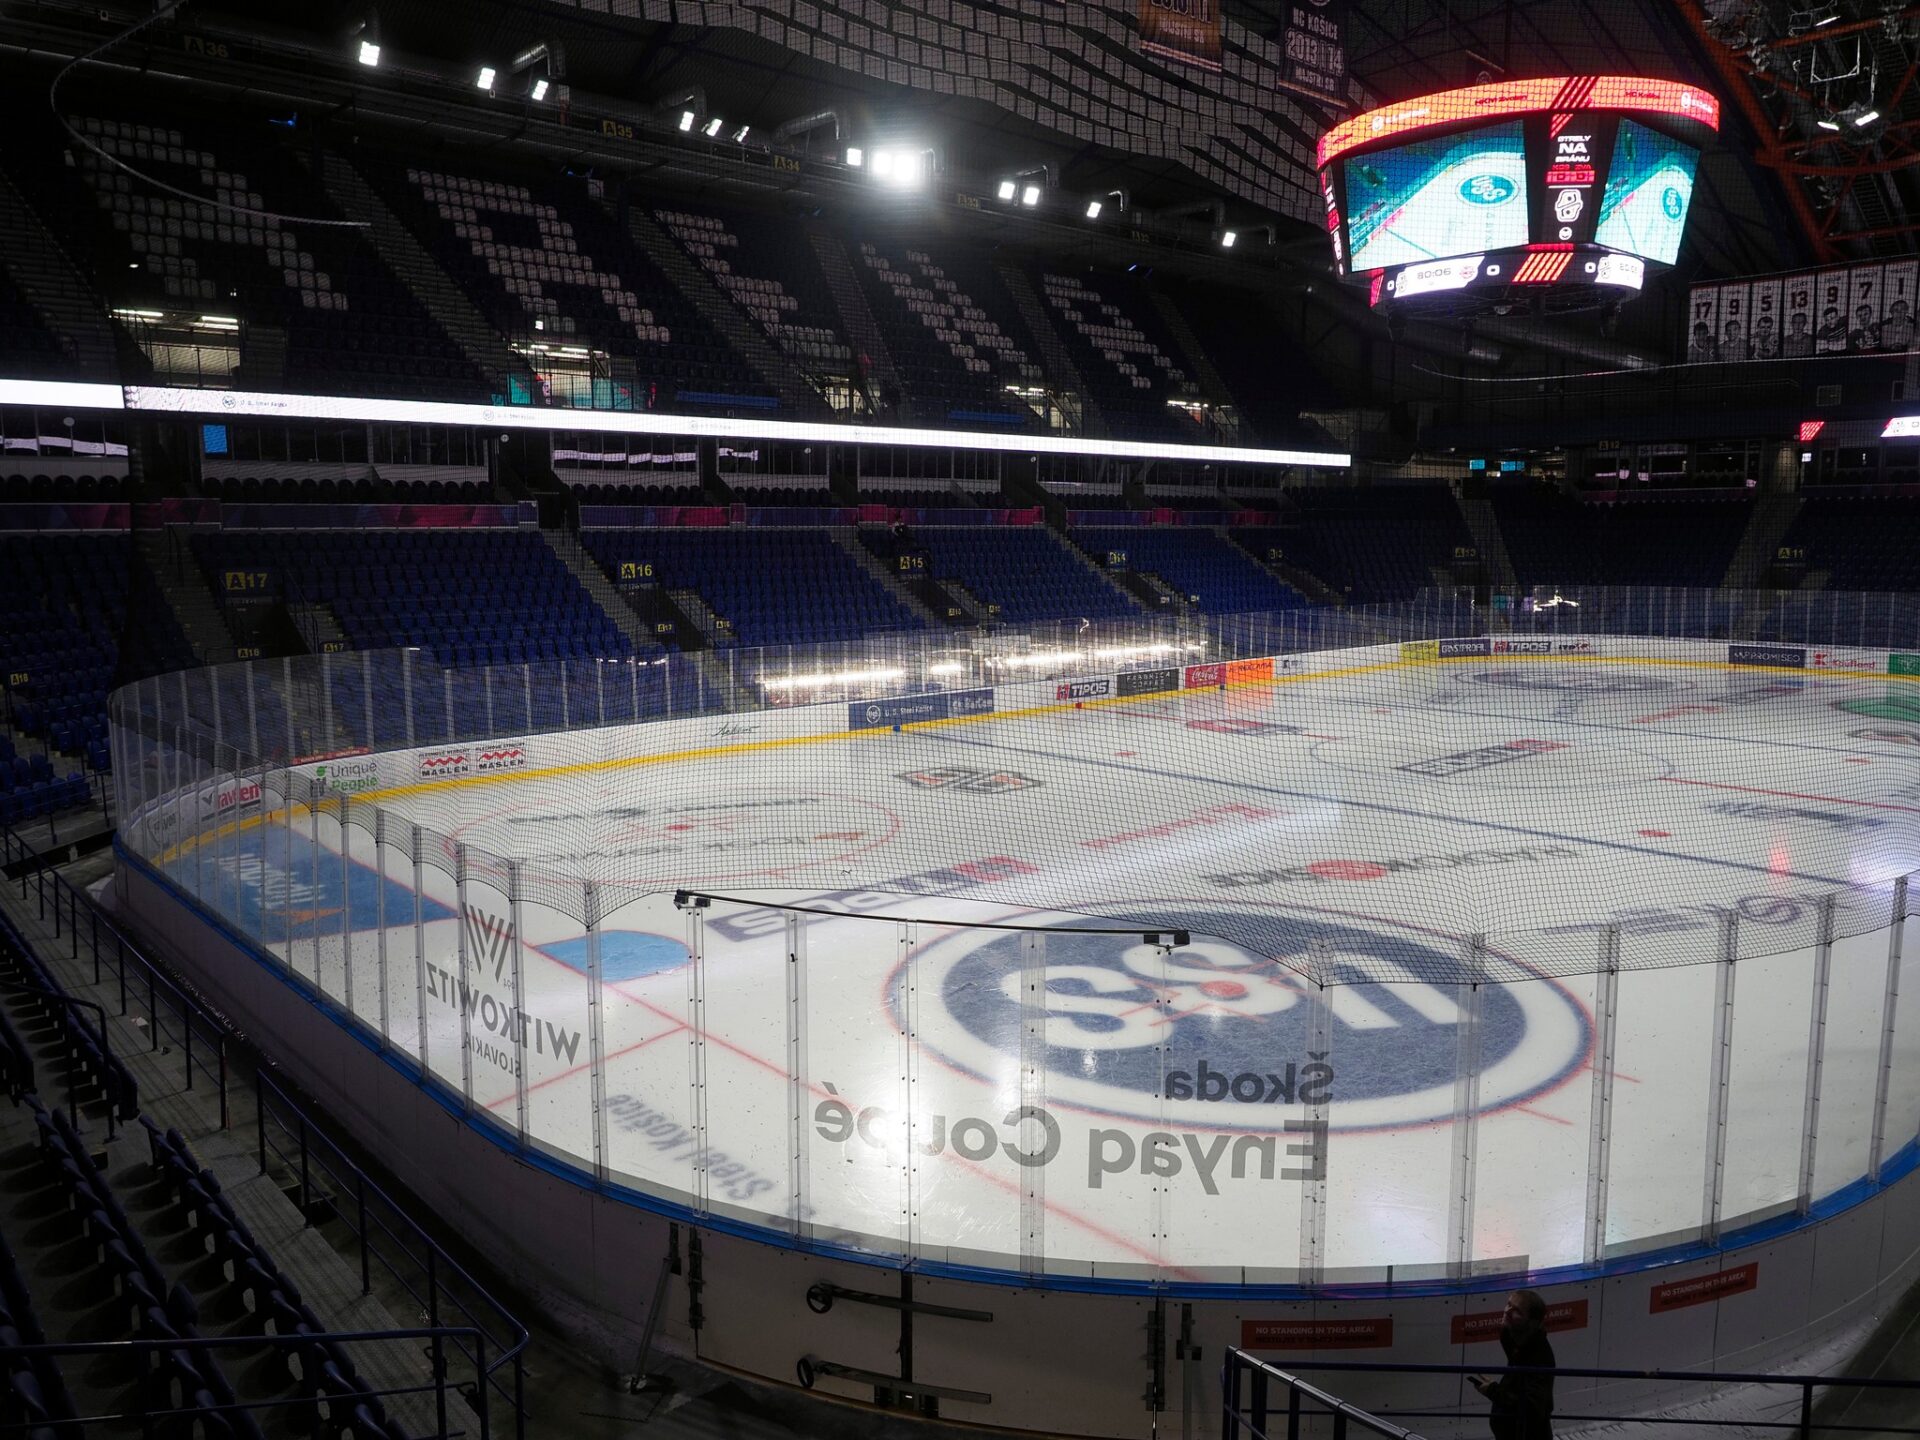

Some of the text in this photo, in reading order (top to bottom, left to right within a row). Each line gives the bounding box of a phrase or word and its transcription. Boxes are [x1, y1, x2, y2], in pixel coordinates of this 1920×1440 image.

[1293, 8, 1338, 40] HC KOŠICE
[603, 119, 633, 139] A35
[1559, 143, 1588, 154] NA
[774, 155, 800, 172] A34
[1858, 282, 1873, 299] 7
[1898, 278, 1904, 295] 1
[1790, 291, 1809, 309] 13
[1827, 286, 1839, 304] 9
[1695, 302, 1712, 319] 17
[1729, 299, 1740, 315] 9
[1761, 296, 1773, 312] 5
[1777, 548, 1803, 559] A11
[621, 563, 653, 579] A16
[900, 556, 924, 570] A15
[225, 572, 268, 590] A17
[324, 643, 344, 653] A17
[1508, 642, 1550, 651] TIPOS
[1832, 658, 1876, 669] Kaufland
[1071, 683, 1107, 696] TIPOS
[331, 762, 378, 778] Unique
[421, 766, 469, 777] MASLEN
[479, 759, 524, 770] MASLEN
[332, 776, 379, 792] People
[1672, 1282, 1704, 1295] STANDING
[1705, 1281, 1712, 1289] IN
[1713, 1277, 1727, 1287] THIS
[1728, 1271, 1746, 1282] AREA!
[1549, 1308, 1572, 1318] AREA!
[1270, 1327, 1313, 1335] STANDING
[1315, 1326, 1325, 1334] IN
[1327, 1326, 1346, 1334] THIS
[1349, 1325, 1375, 1333] AREA!
[1465, 1318, 1505, 1329] NO STAN
